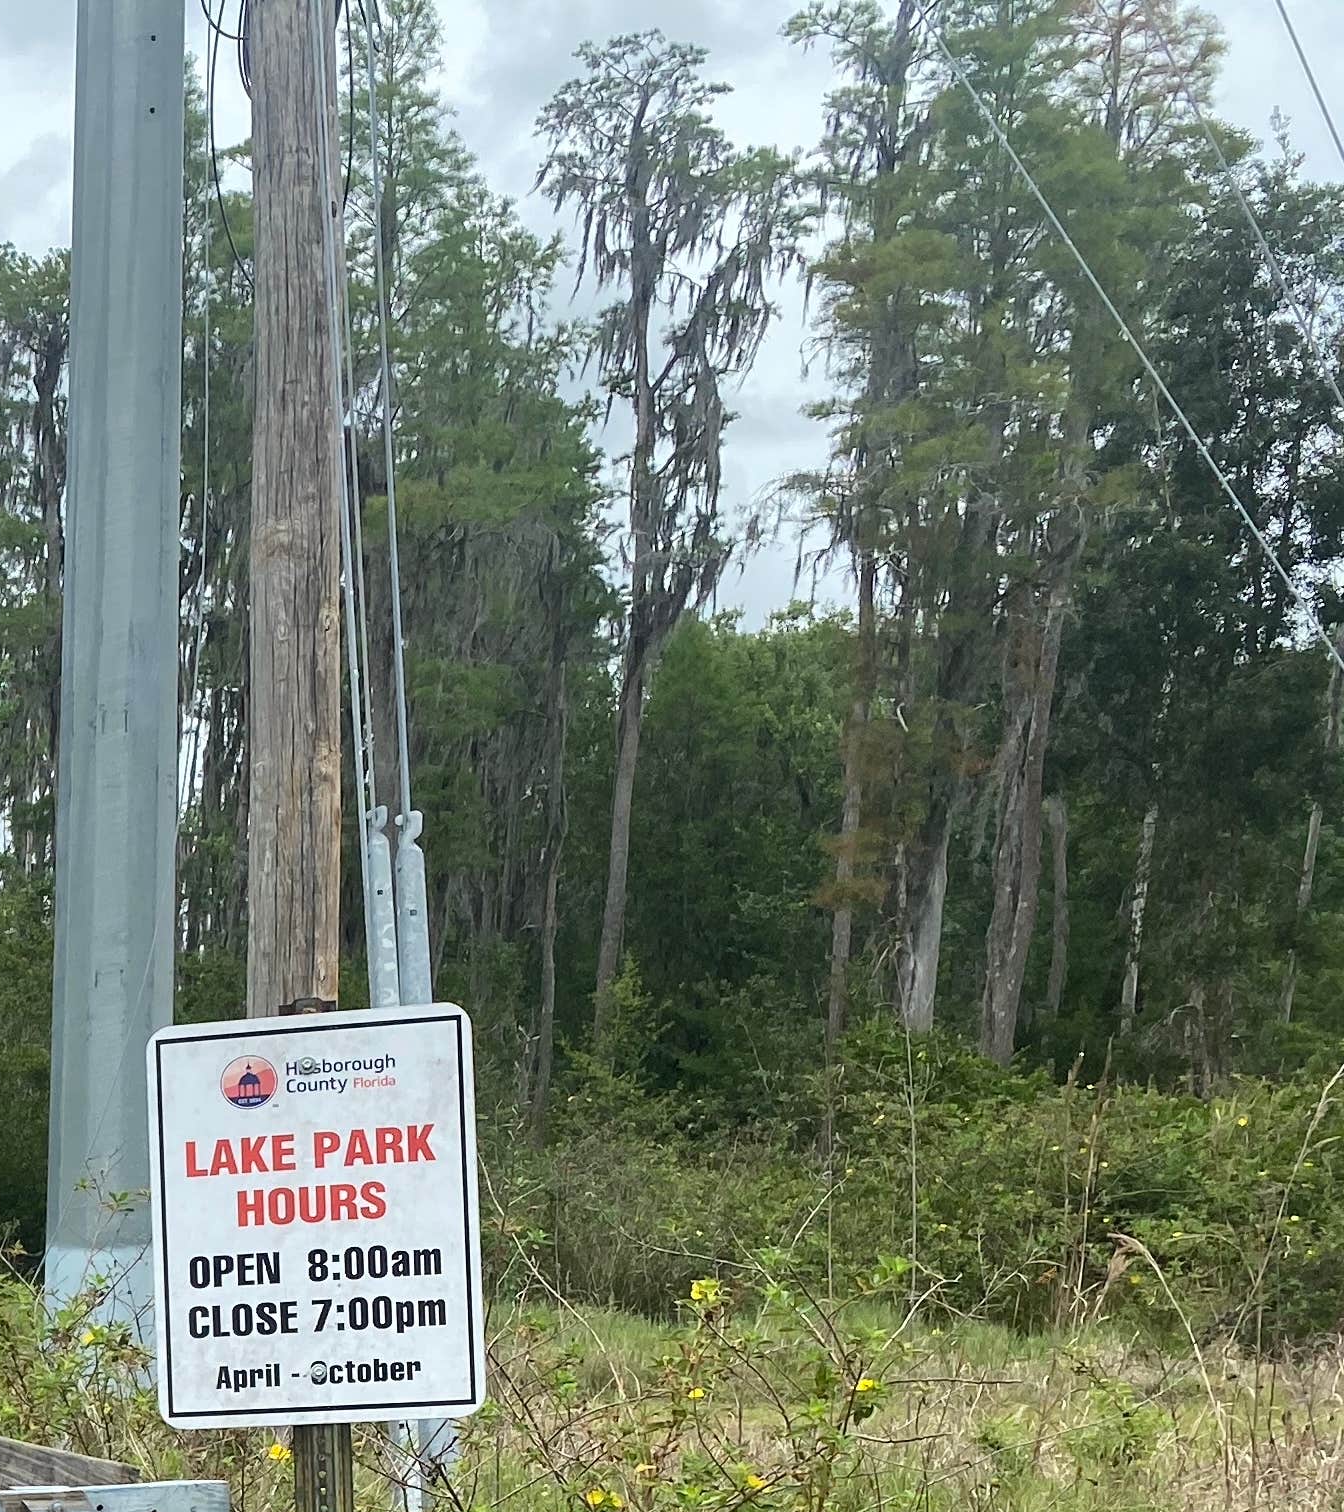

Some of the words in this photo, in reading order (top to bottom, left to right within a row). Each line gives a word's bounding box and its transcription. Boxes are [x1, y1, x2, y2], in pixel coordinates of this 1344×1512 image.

[286, 1053, 396, 1076] Hsborough
[286, 1076, 348, 1094] County
[353, 1075, 396, 1089] Florida
[185, 1133, 297, 1178] LAKE
[313, 1123, 437, 1169] PARK
[236, 1181, 387, 1228] HOURS
[188, 1251, 281, 1289] OPEN
[307, 1244, 443, 1283] 8:00am
[188, 1300, 299, 1339] CLOSE
[311, 1295, 448, 1334] 7:00pm
[216, 1363, 281, 1393] April
